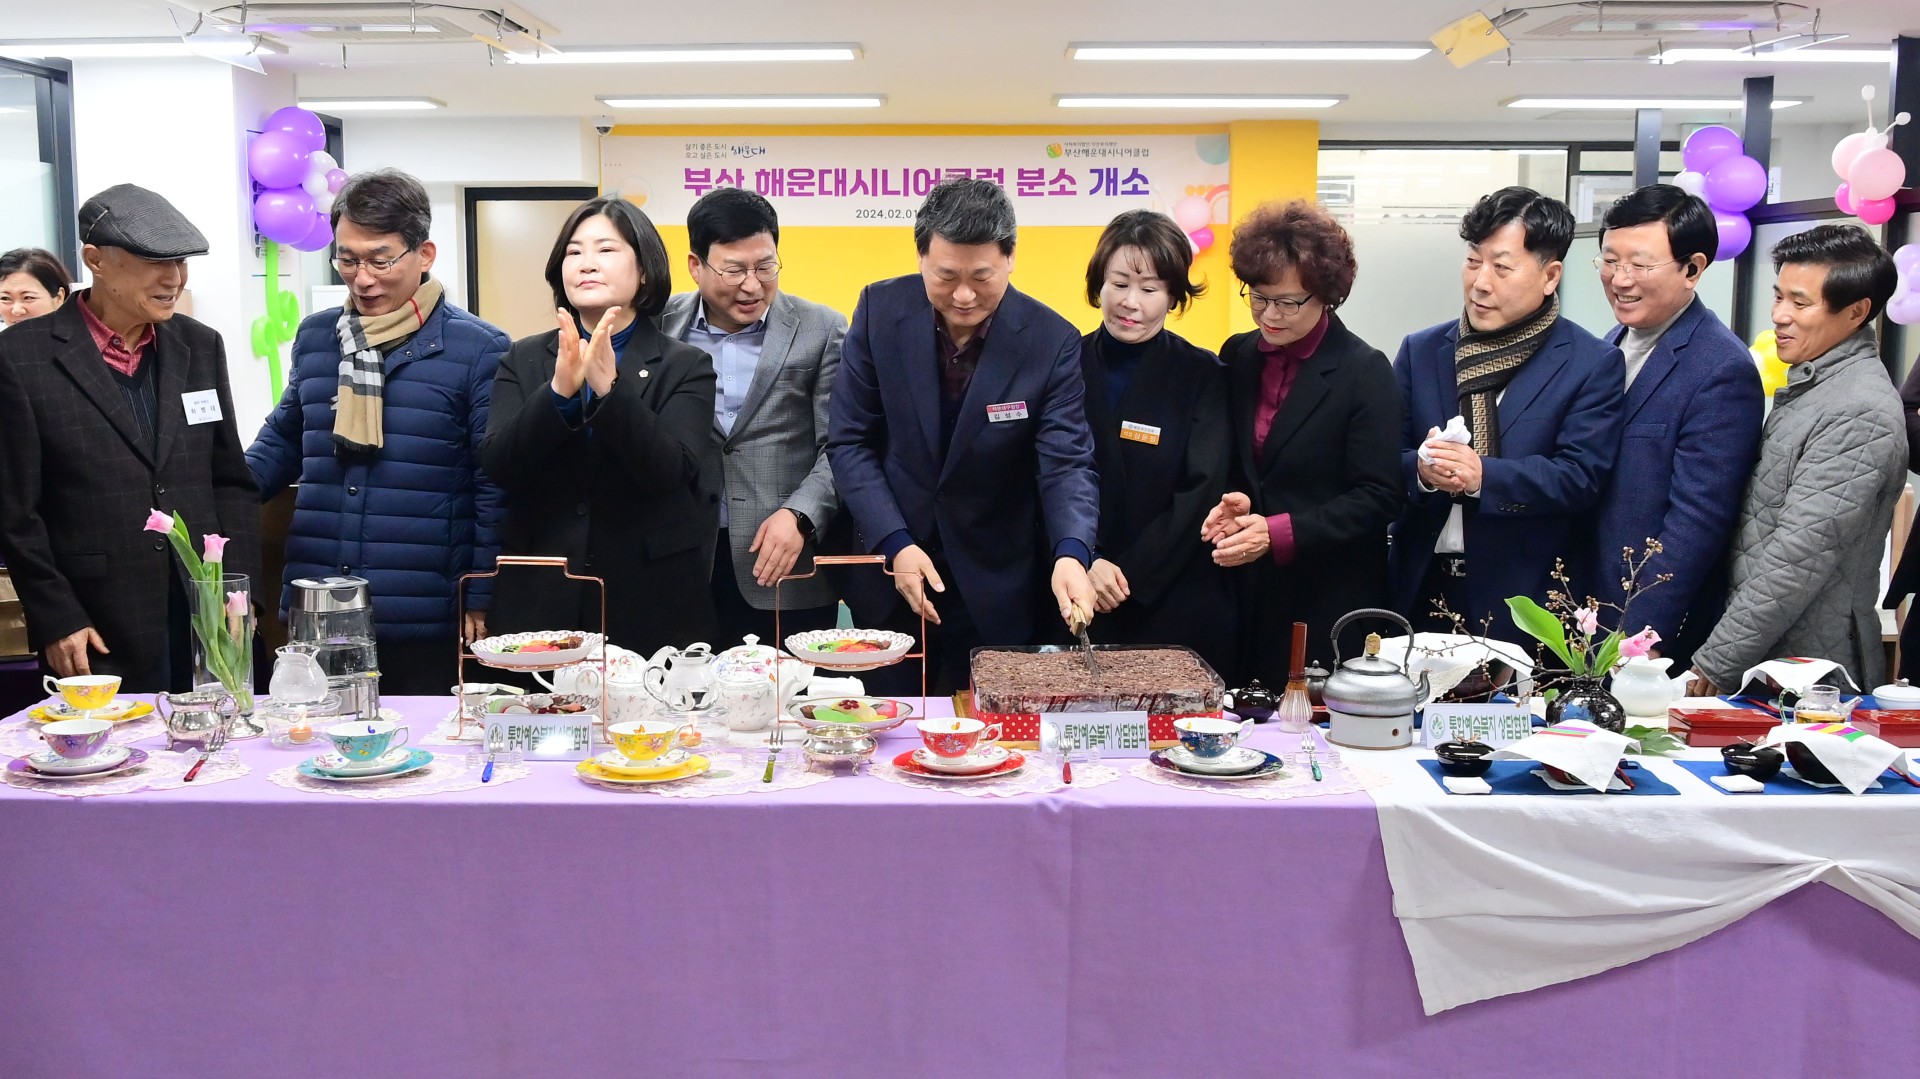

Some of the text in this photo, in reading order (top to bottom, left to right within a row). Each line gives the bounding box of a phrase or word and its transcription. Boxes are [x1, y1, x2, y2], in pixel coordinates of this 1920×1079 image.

[1064, 148, 1150, 158] 부산해운대시니어클럽
[684, 168, 745, 197] 부산
[1017, 167, 1078, 197] 분소
[1089, 167, 1150, 197] 개소
[1064, 723, 1147, 750] 통합예술복지 상담협회
[1449, 714, 1530, 741] 통합예술복지 상담협회
